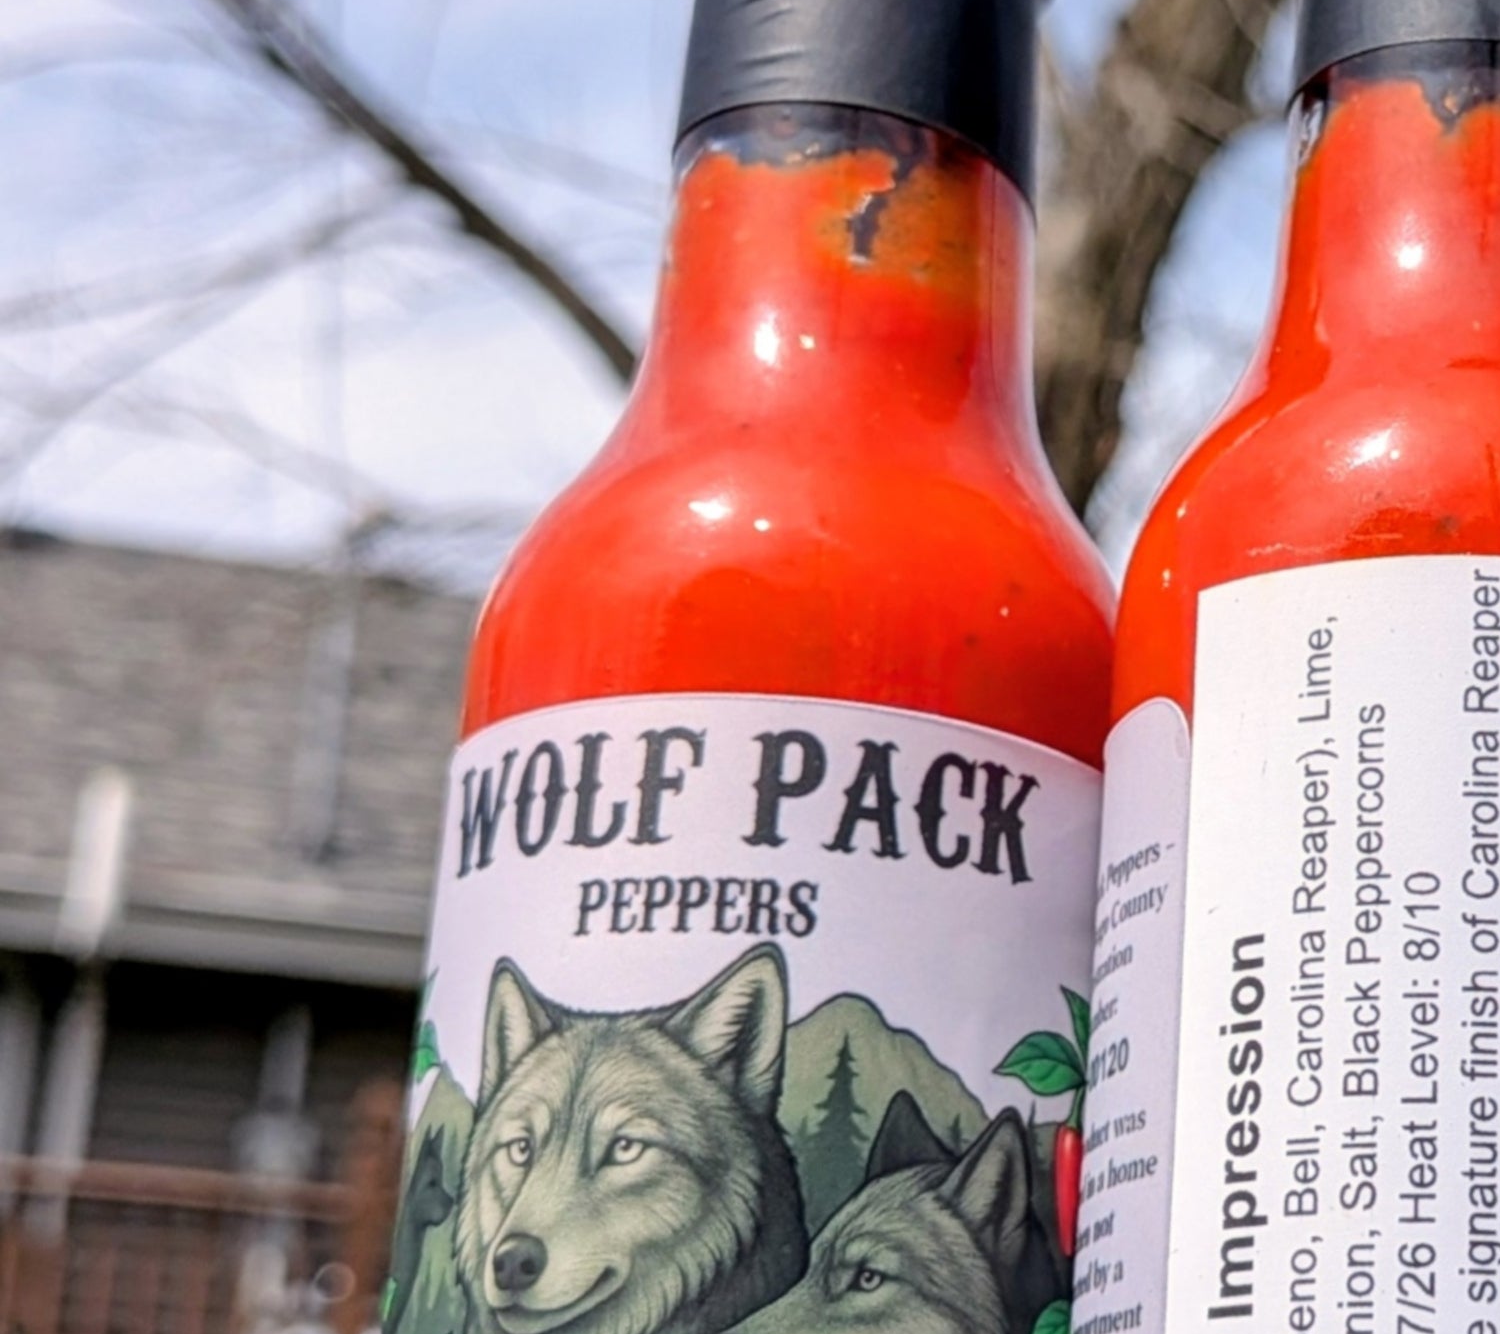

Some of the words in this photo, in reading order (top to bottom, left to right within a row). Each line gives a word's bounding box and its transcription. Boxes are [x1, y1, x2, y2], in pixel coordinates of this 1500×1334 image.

[1298, 617, 1337, 723] Lime,
[456, 727, 707, 879] WOLF
[741, 729, 1040, 885] PACK
[1292, 738, 1338, 914] Reaper),
[1345, 704, 1391, 965] Peppercorns
[1461, 731, 1500, 900] Carolina
[573, 875, 819, 938] PEPPERS
[1111, 884, 1168, 929] County
[1403, 872, 1441, 961] 8/10
[1461, 912, 1499, 954] of
[1287, 930, 1326, 1107] Carolina
[1342, 980, 1381, 1097] Black
[1401, 979, 1440, 1104] Level:
[1460, 971, 1499, 1081] finish
[1107, 1155, 1158, 1189] home
[1114, 1110, 1146, 1138] was
[1207, 933, 1268, 1320] Impression
[1284, 1125, 1326, 1217] Bell,
[1339, 1116, 1384, 1211] Salt,
[1398, 1120, 1438, 1223] Heat
[1093, 1258, 1112, 1295] by
[1114, 1260, 1124, 1285] a
